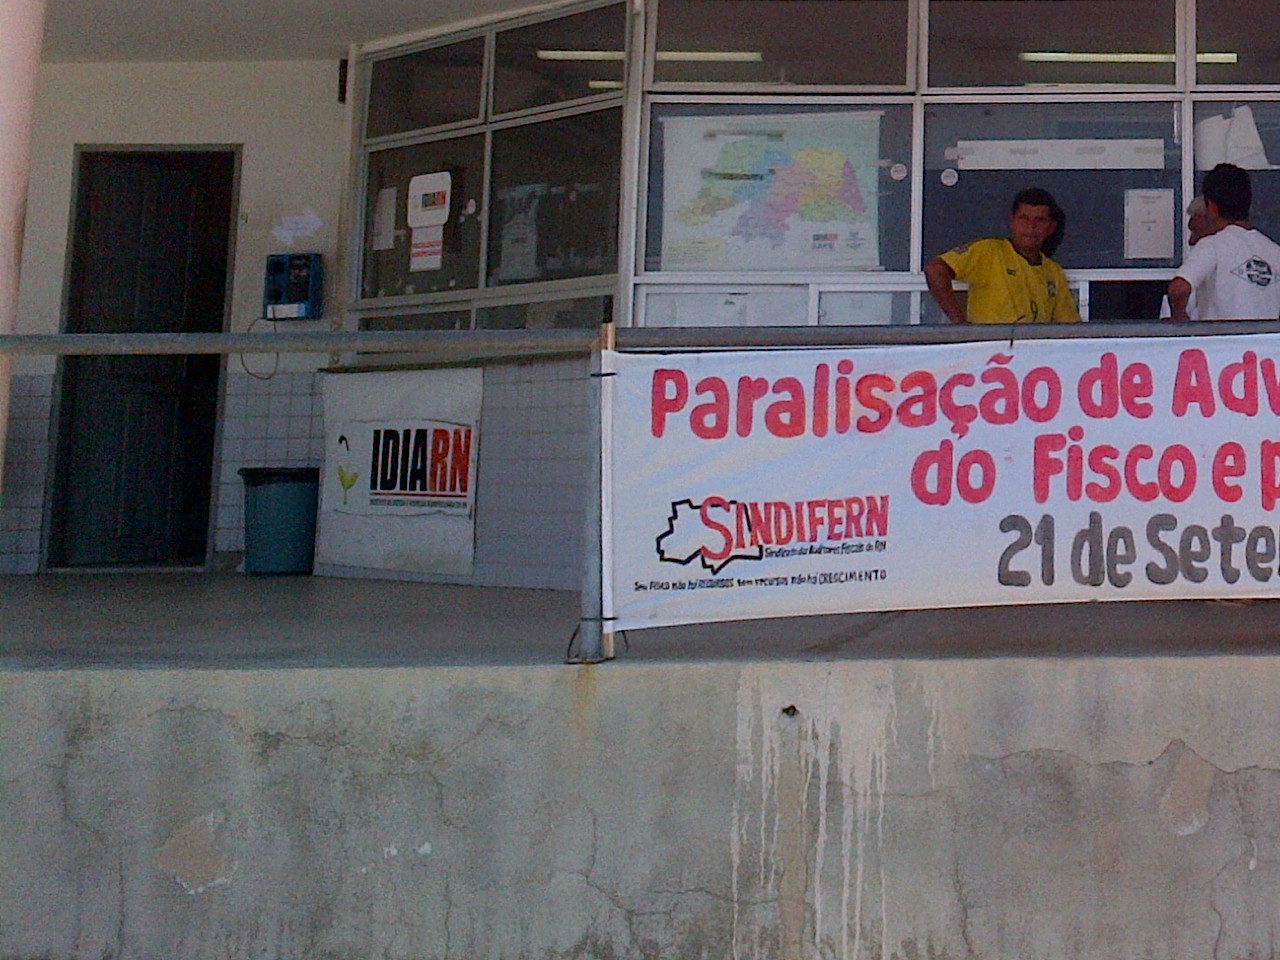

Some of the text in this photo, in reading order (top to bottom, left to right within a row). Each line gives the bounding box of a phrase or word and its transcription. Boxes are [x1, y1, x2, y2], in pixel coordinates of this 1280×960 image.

[651, 354, 1062, 439] Paralisação
[1078, 352, 1153, 418] de
[911, 439, 996, 505] do
[1034, 426, 1198, 503] Fisco
[1212, 441, 1247, 503] e
[700, 495, 889, 561] SINDIFERN
[997, 513, 1055, 588] 21
[1070, 511, 1137, 589] de
[818, 569, 887, 585] CRESCIMENTO
